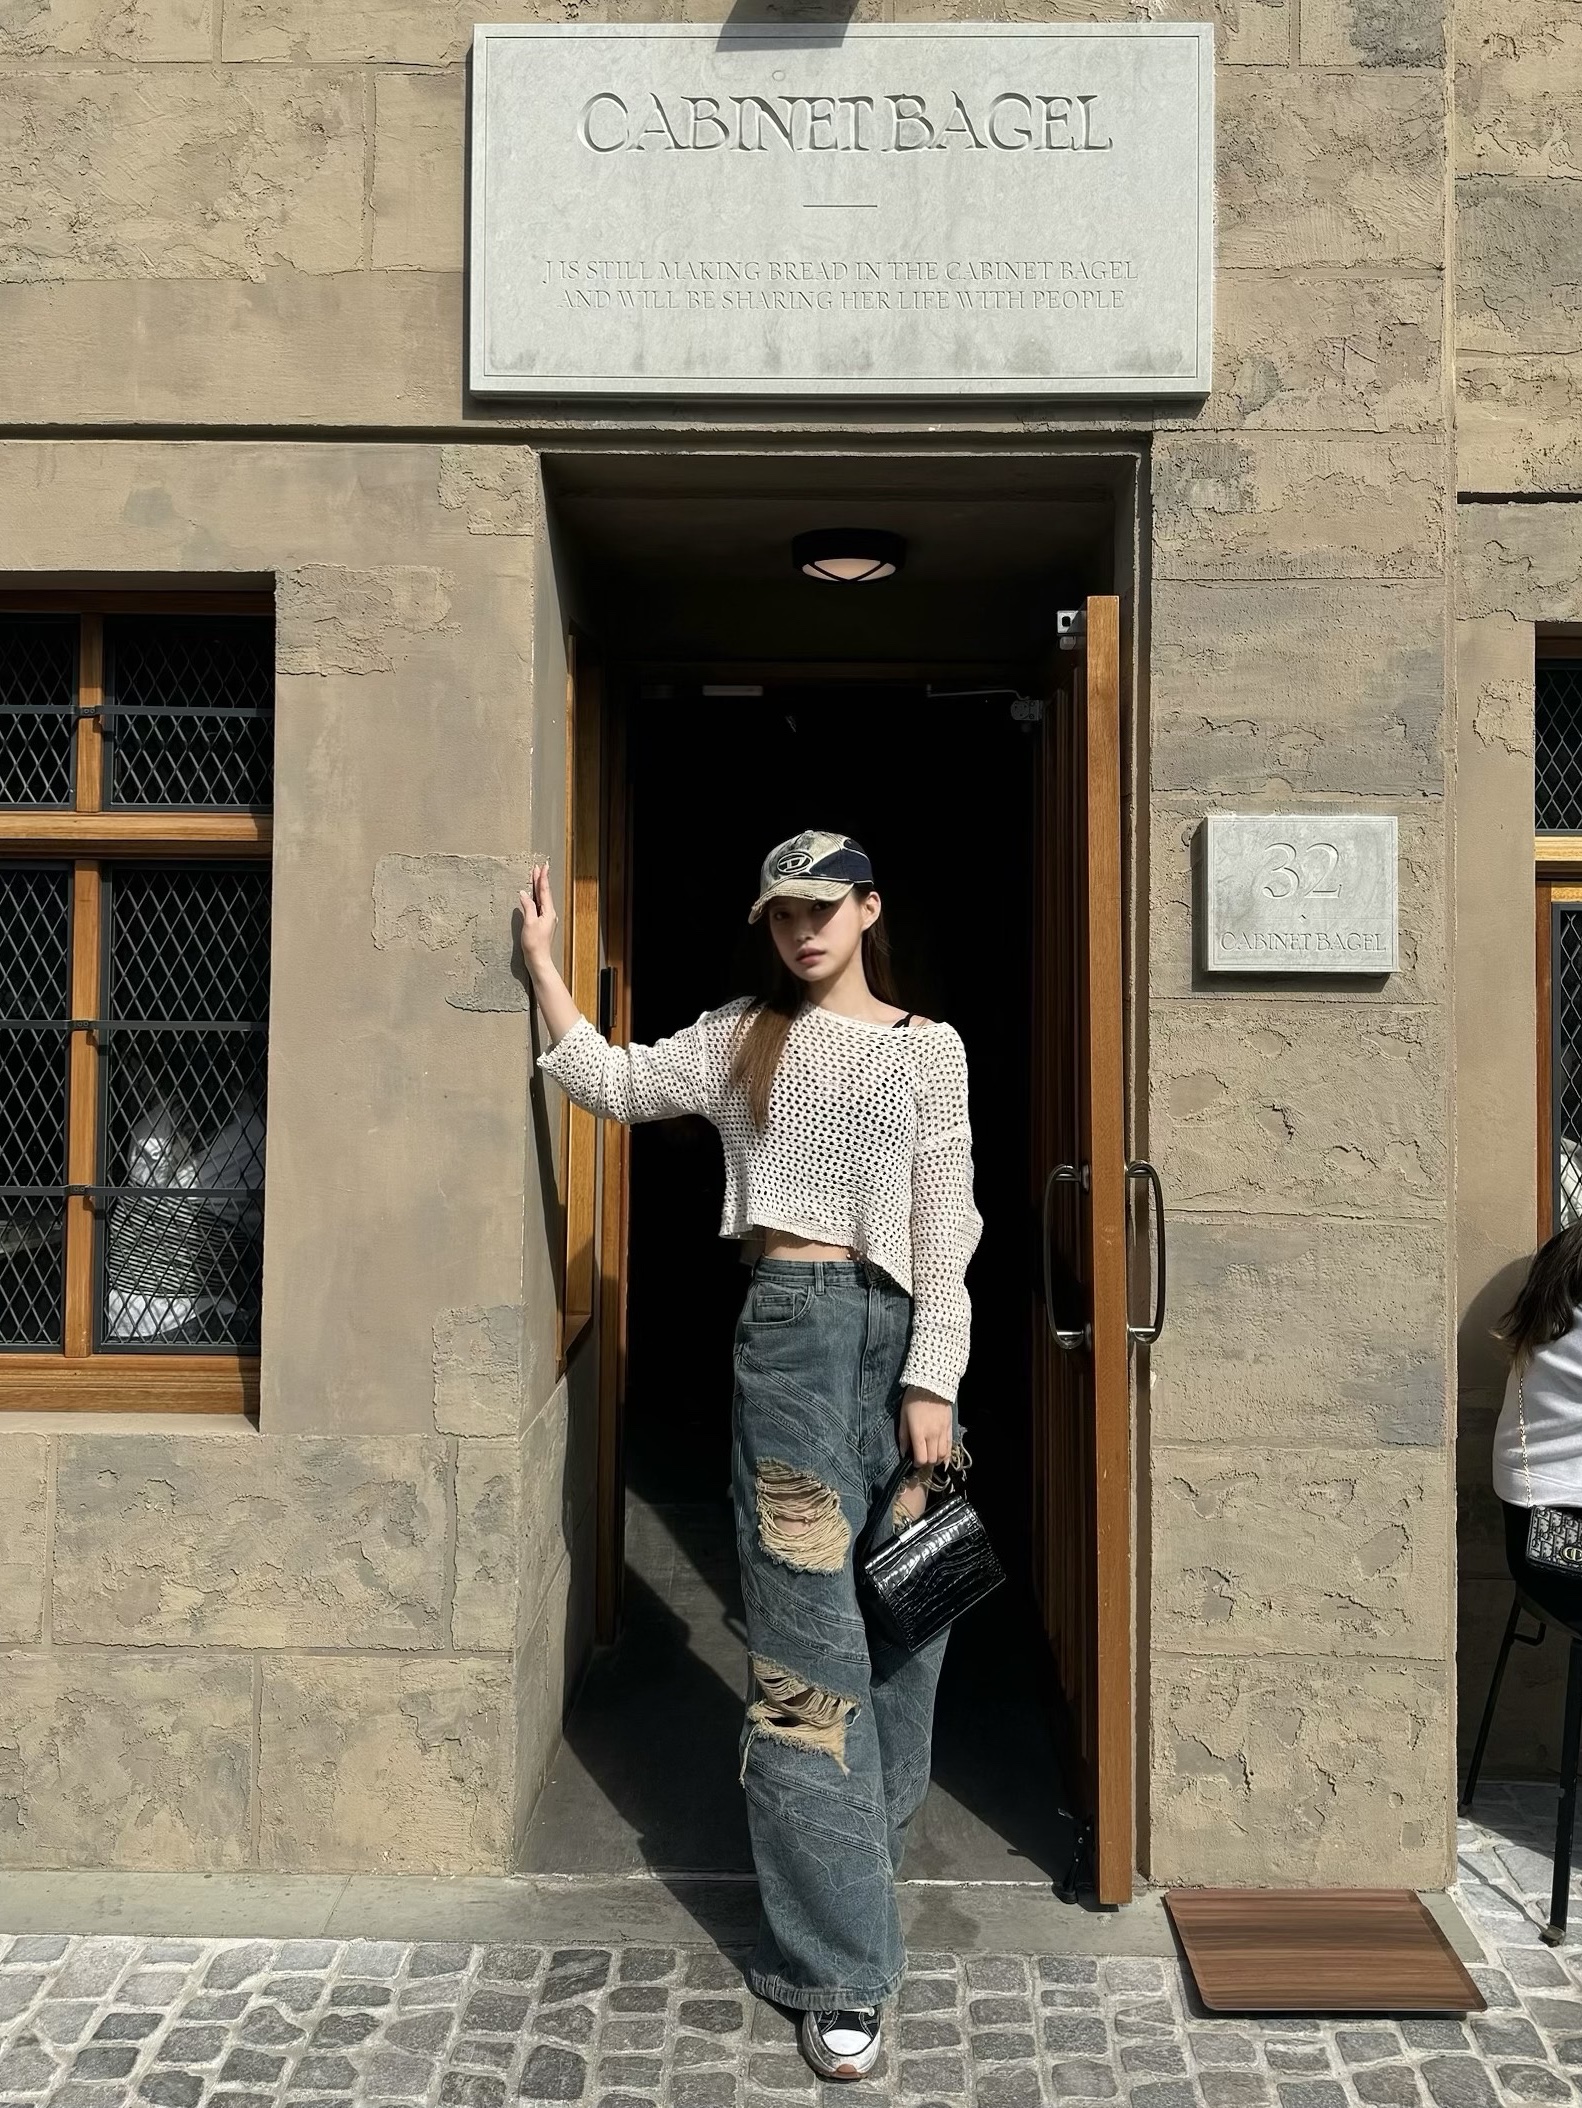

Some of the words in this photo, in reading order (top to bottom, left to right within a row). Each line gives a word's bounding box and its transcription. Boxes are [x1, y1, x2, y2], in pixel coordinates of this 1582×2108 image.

[577, 91, 874, 153] CABINET
[881, 90, 1114, 154] BAGEL
[542, 260, 553, 284] J
[558, 260, 580, 280] IS
[585, 260, 652, 280] STILL
[658, 261, 761, 280] MAKING
[767, 261, 848, 281] BREAD
[854, 261, 882, 281] IN
[887, 261, 939, 281] THE
[945, 261, 1053, 281] CABINET
[1059, 260, 1138, 281] BAGEL
[557, 289, 611, 309] AND
[617, 289, 679, 309] WILL
[685, 290, 716, 309] BE
[721, 290, 832, 310] SHARING
[840, 290, 891, 310] HER
[897, 290, 950, 310] LIFE
[955, 290, 1025, 309] WITH
[1031, 289, 1125, 310] PEOPLE
[1262, 841, 1343, 900] 32
[1219, 931, 1312, 952] CABINET
[1316, 931, 1387, 953] BAGEL
